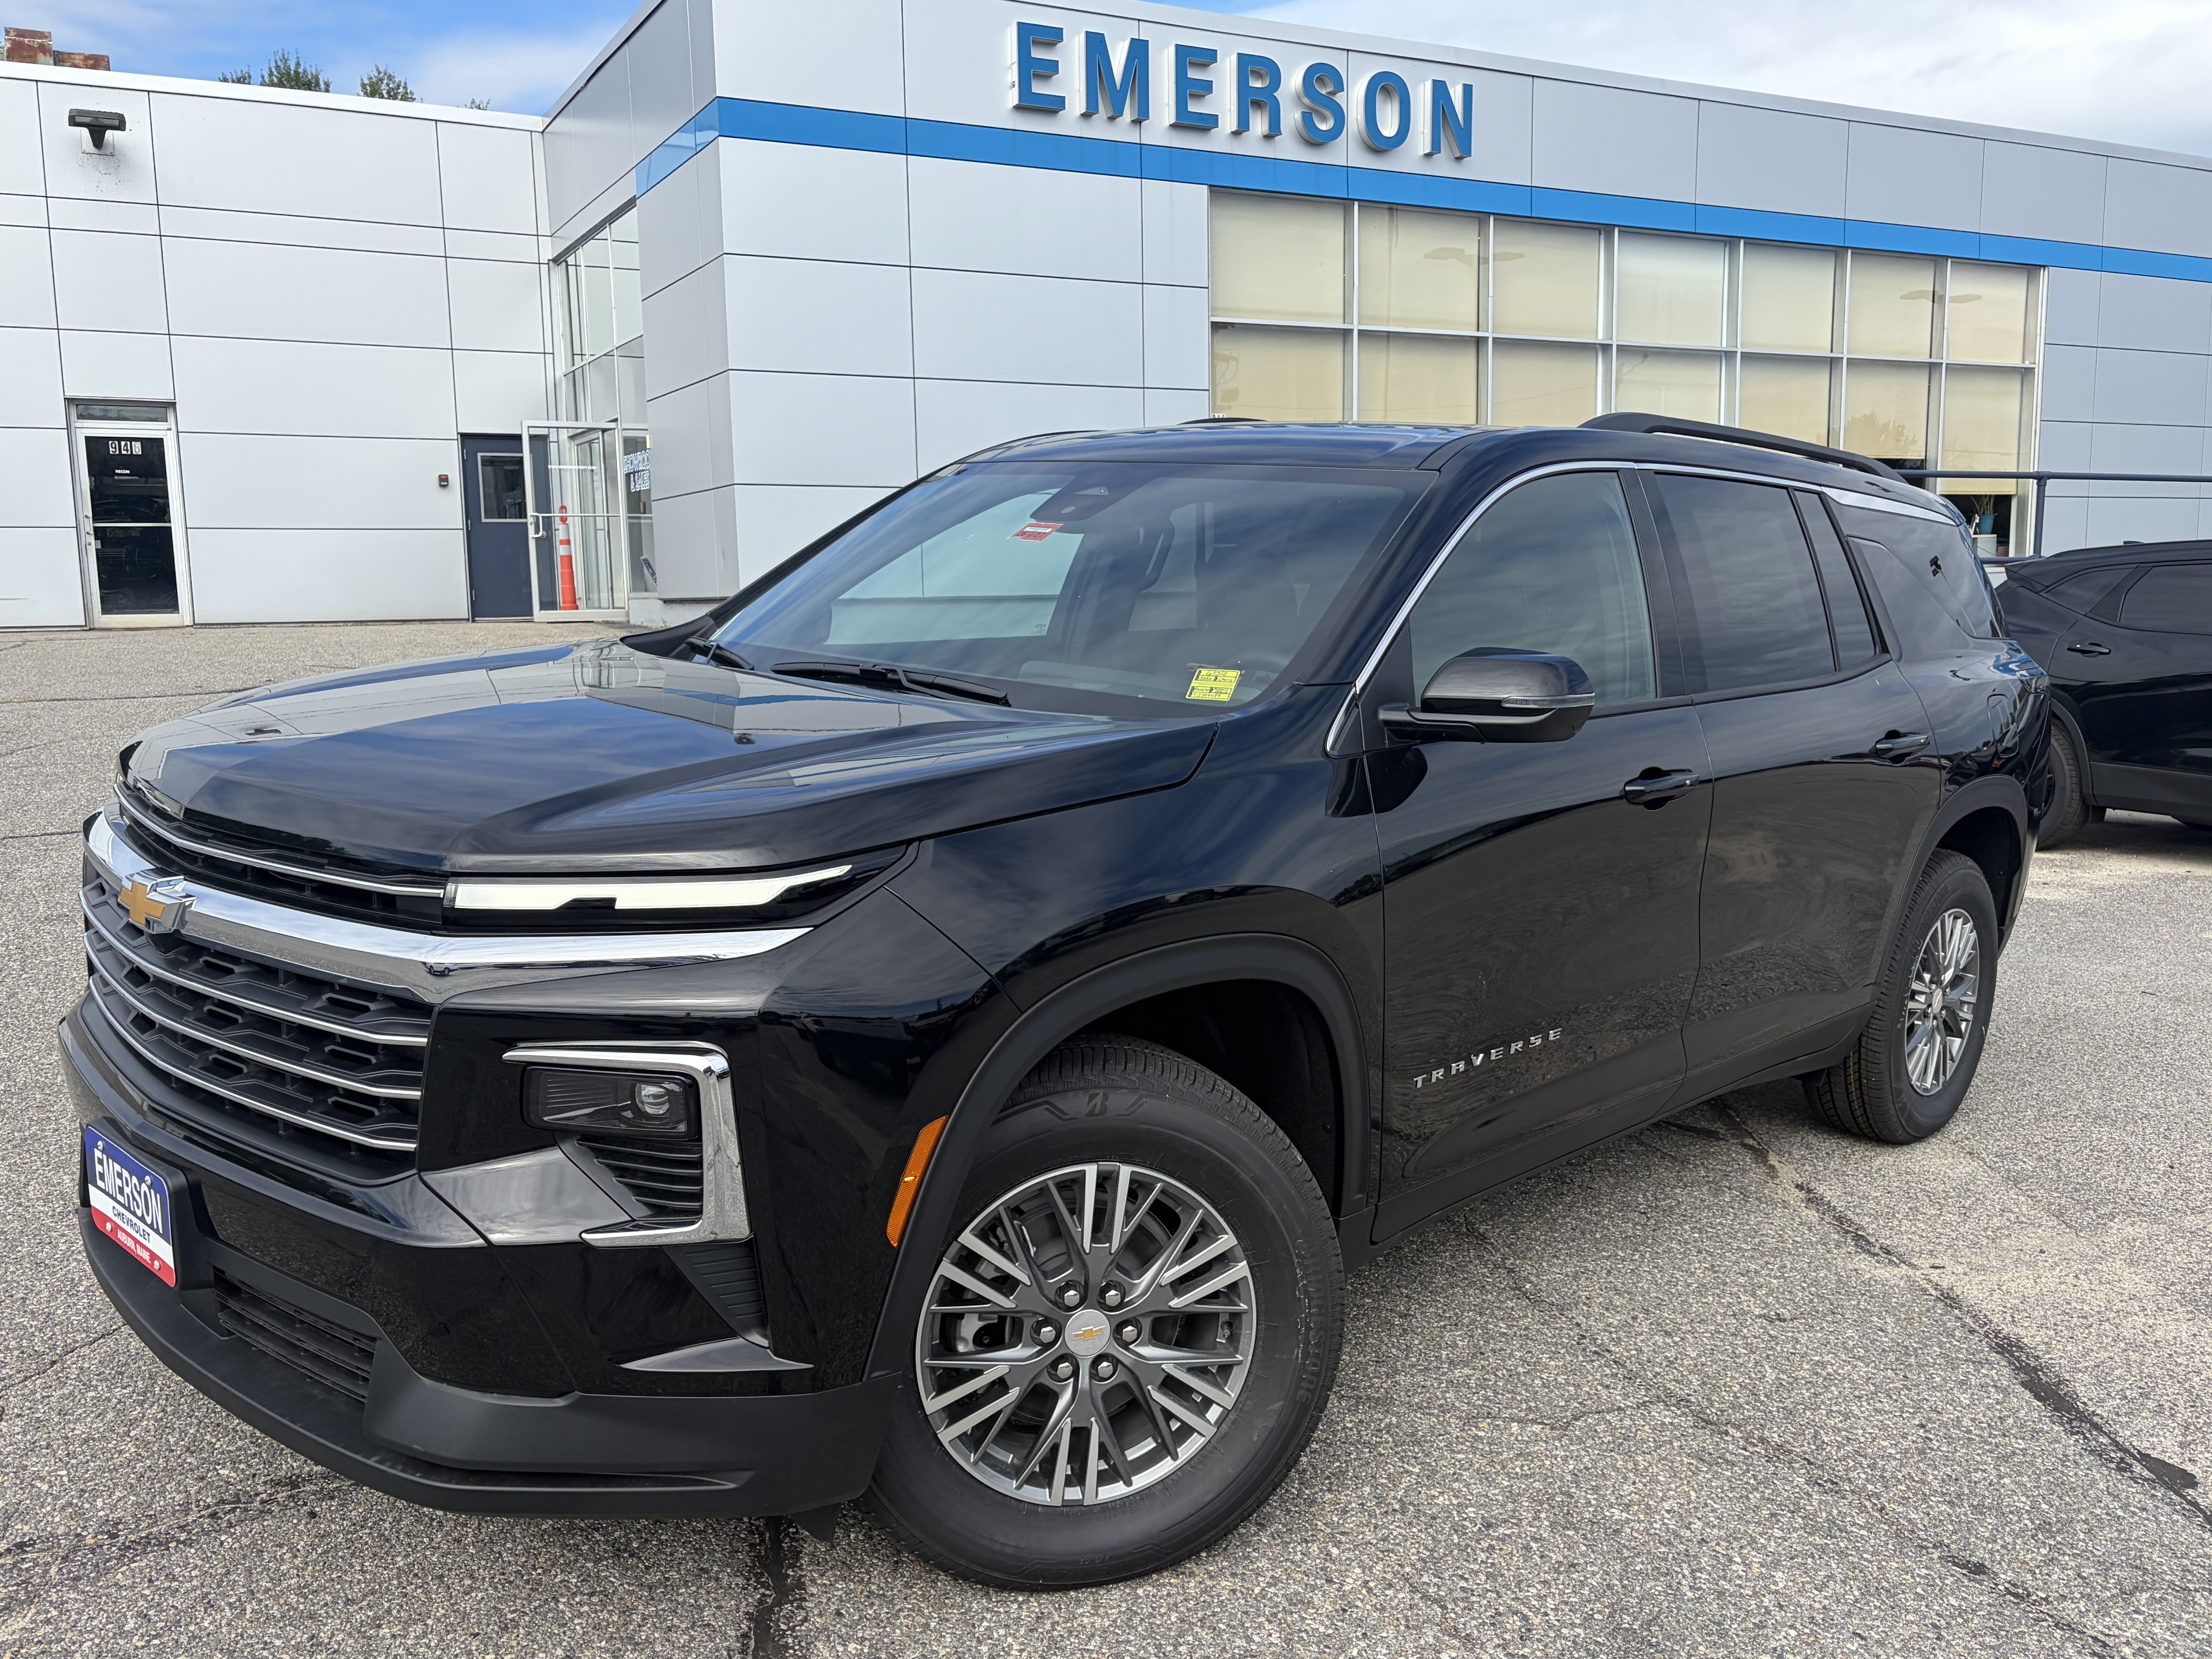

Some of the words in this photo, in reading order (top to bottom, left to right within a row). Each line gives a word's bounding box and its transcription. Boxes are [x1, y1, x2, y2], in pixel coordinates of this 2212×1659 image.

[1012, 21, 1473, 160] EMERSON
[110, 441, 140, 453] 946
[623, 450, 651, 474] SHOWROO
[635, 471, 650, 491] SALES
[1413, 1028, 1561, 1088] TRAVERSE
[94, 1147, 163, 1234] EMERSON
[112, 1206, 150, 1243] CHEVROLET
[117, 1228, 136, 1254] AUBURN,
[136, 1243, 151, 1264] MAINE
